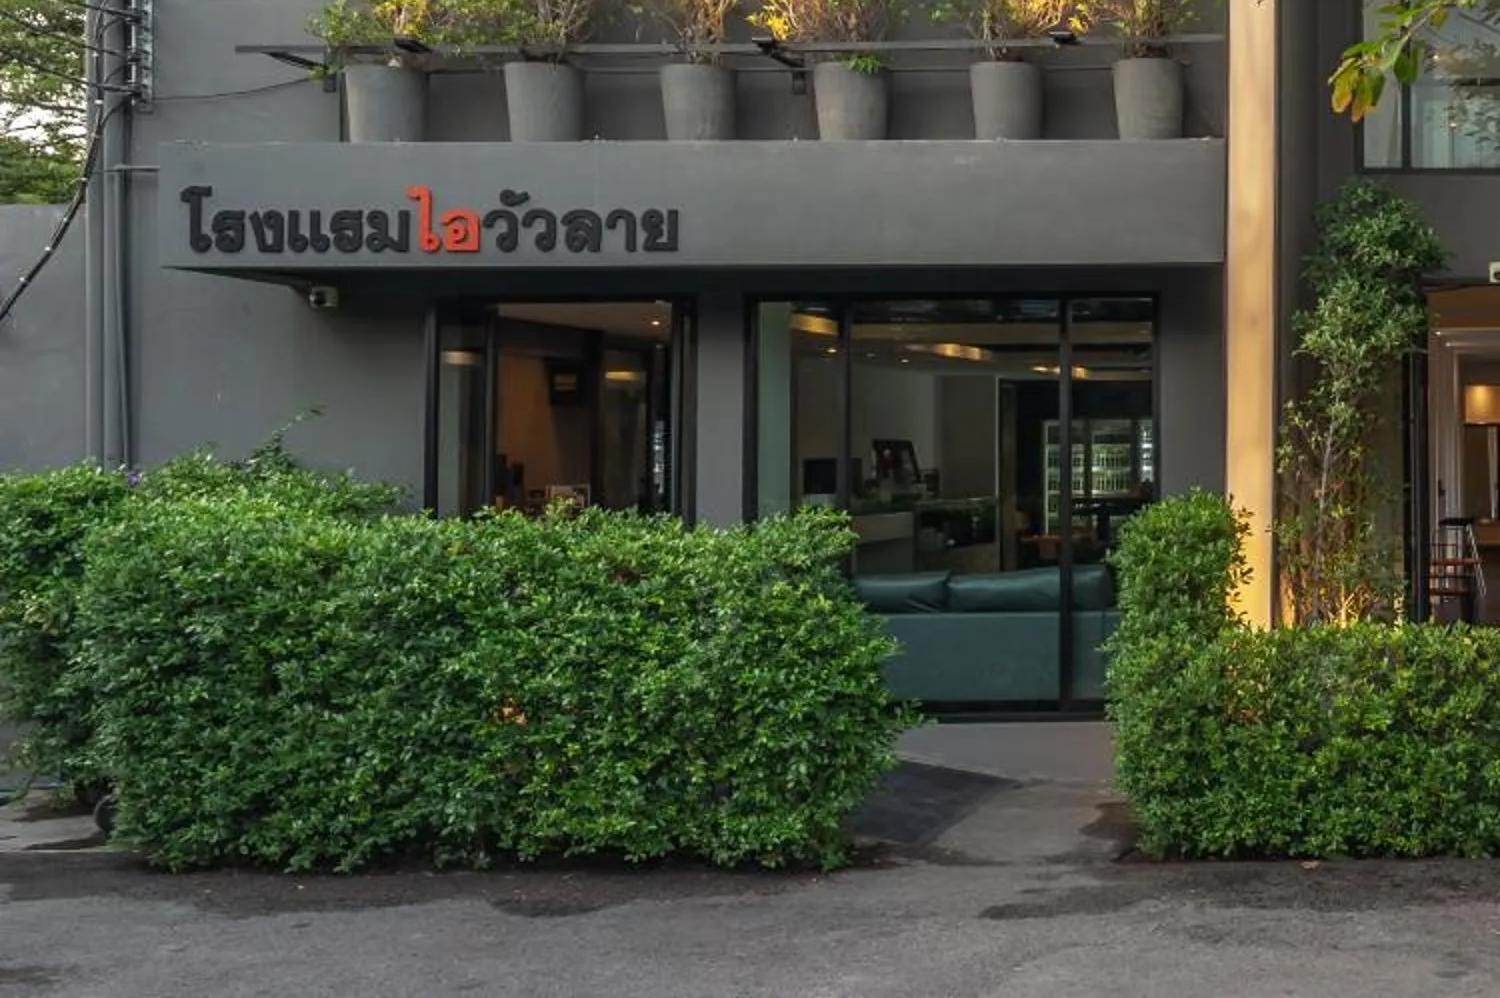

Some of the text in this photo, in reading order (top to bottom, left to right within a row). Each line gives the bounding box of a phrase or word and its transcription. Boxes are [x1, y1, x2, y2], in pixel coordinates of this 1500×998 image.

[180, 185, 679, 254] โรงแรมไอวัวลาย
